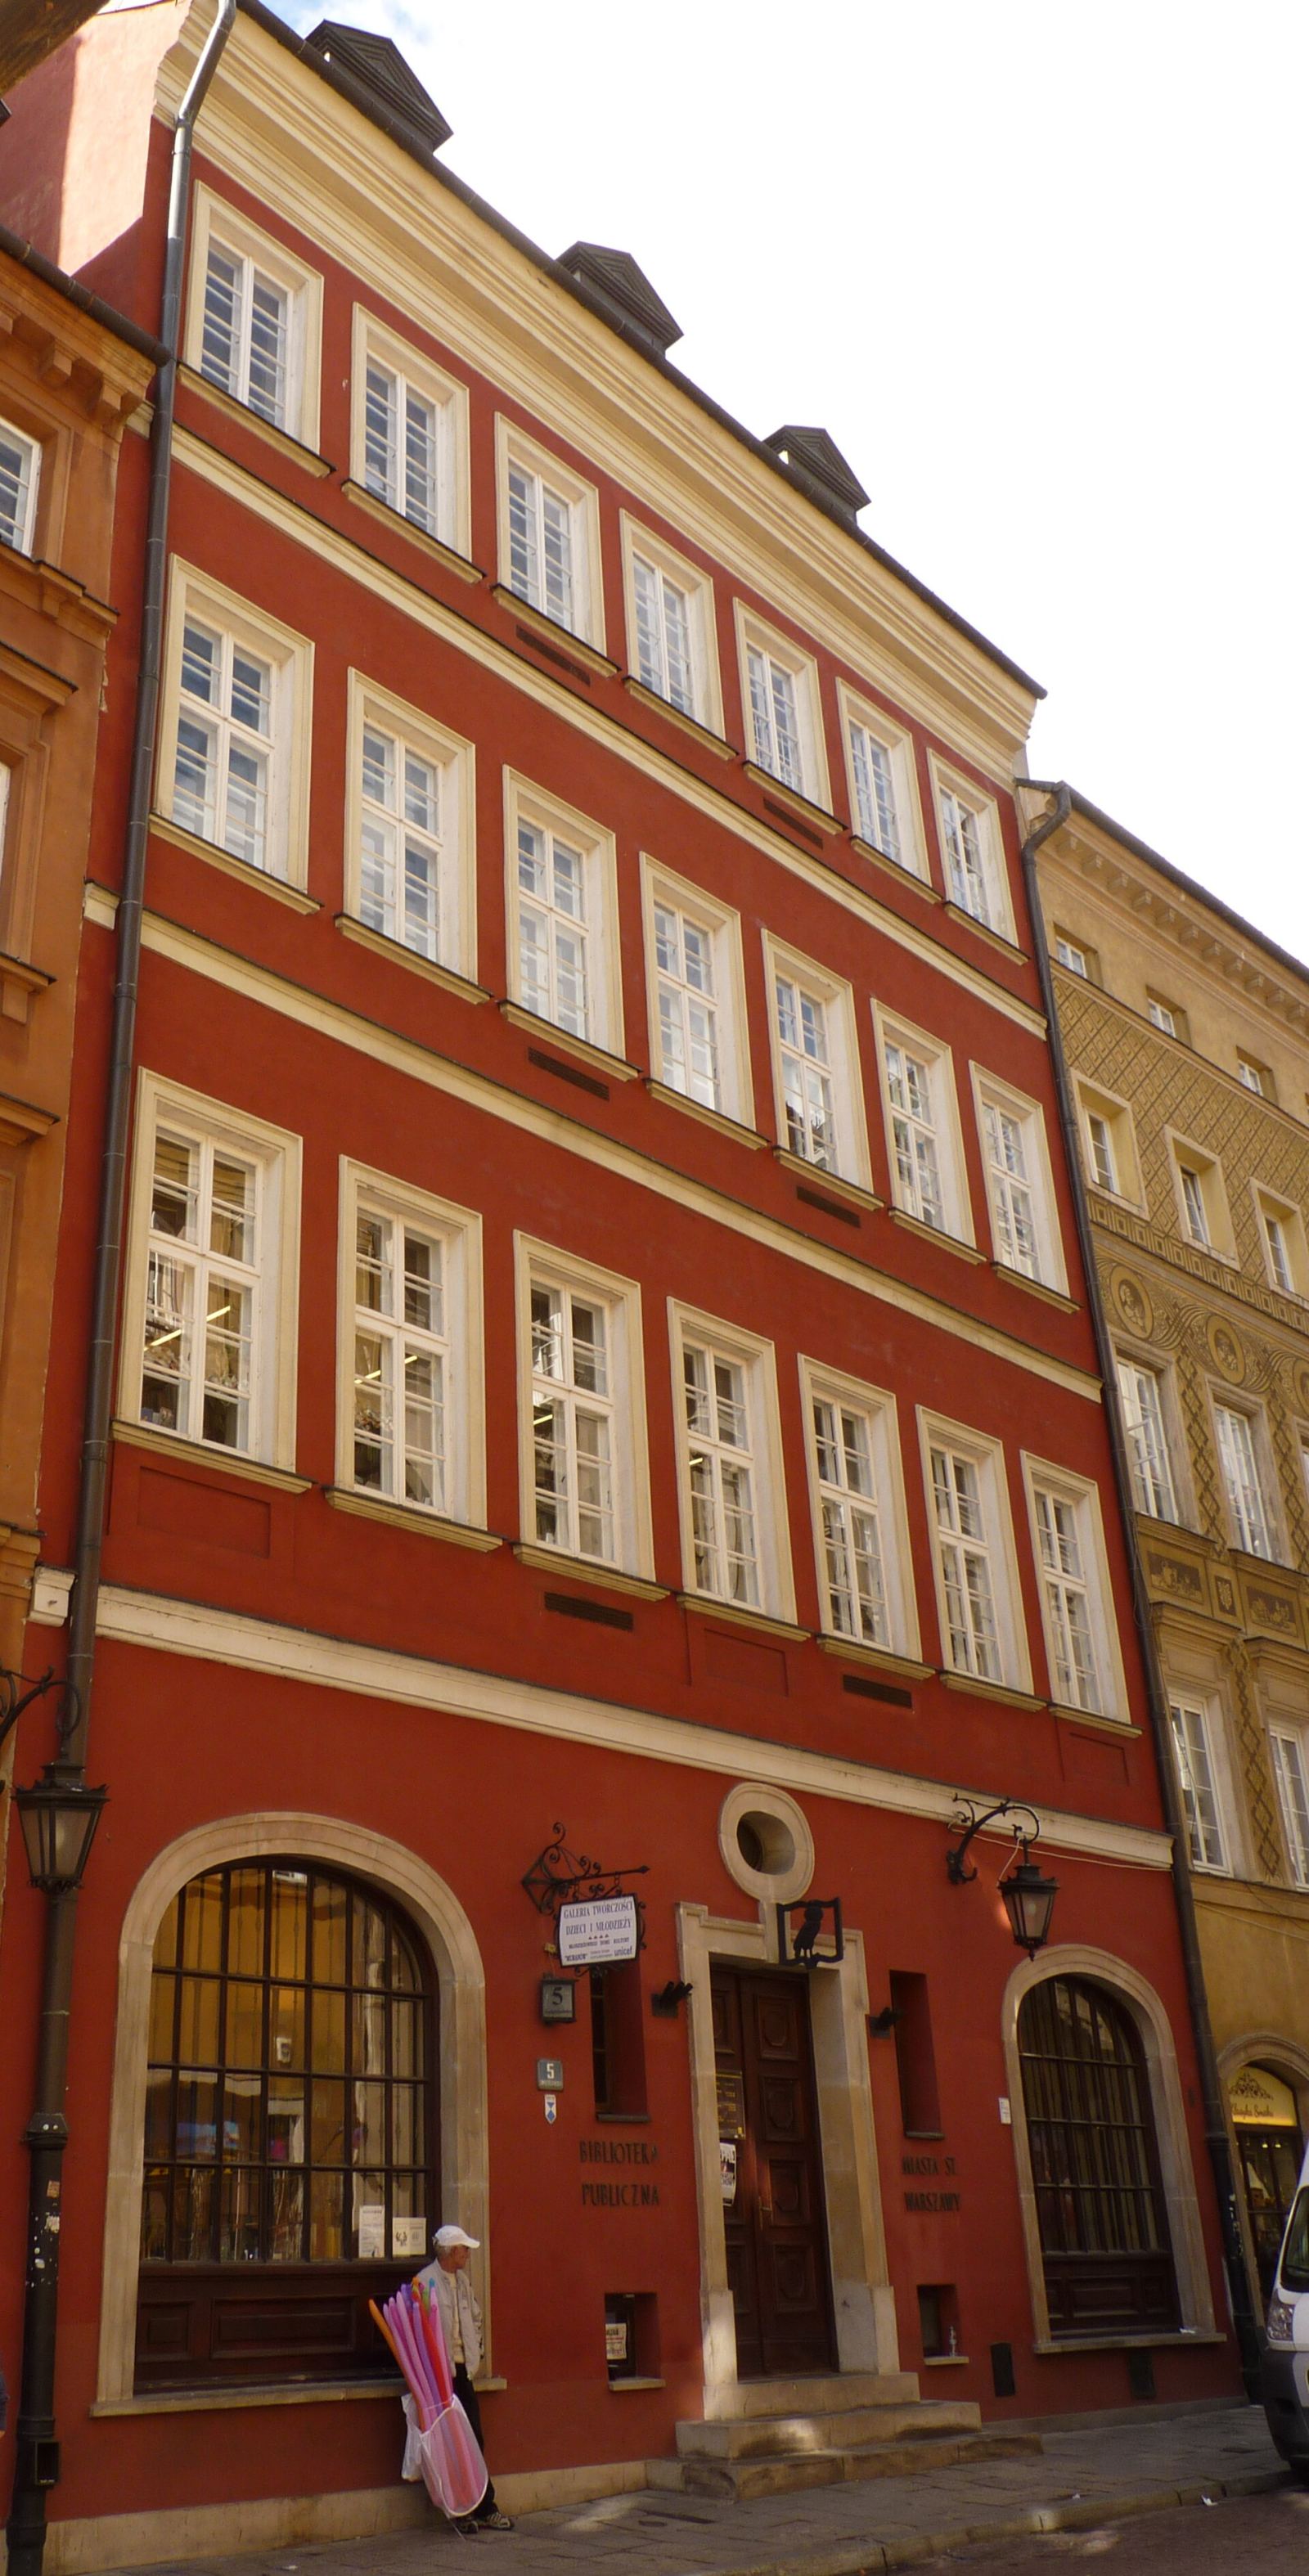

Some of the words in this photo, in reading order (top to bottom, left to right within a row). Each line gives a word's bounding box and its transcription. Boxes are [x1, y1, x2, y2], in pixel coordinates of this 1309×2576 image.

[564, 1907, 590, 1918] GALERIA
[592, 1900, 632, 1915] TWÓRCZOŚCI
[566, 1923, 586, 1935] DZIECI
[590, 1922, 593, 1932] I
[596, 1917, 631, 1931] MŁODZIEŻY
[614, 1945, 632, 1956] unicef
[552, 1986, 563, 2005] 5
[547, 2062, 555, 2079] 5
[579, 2141, 659, 2164] BIBLIOTEKA
[902, 2156, 938, 2174] MIASTA
[582, 2183, 659, 2205] PUBLICZNA
[904, 2192, 960, 2212] WARSZAWY
